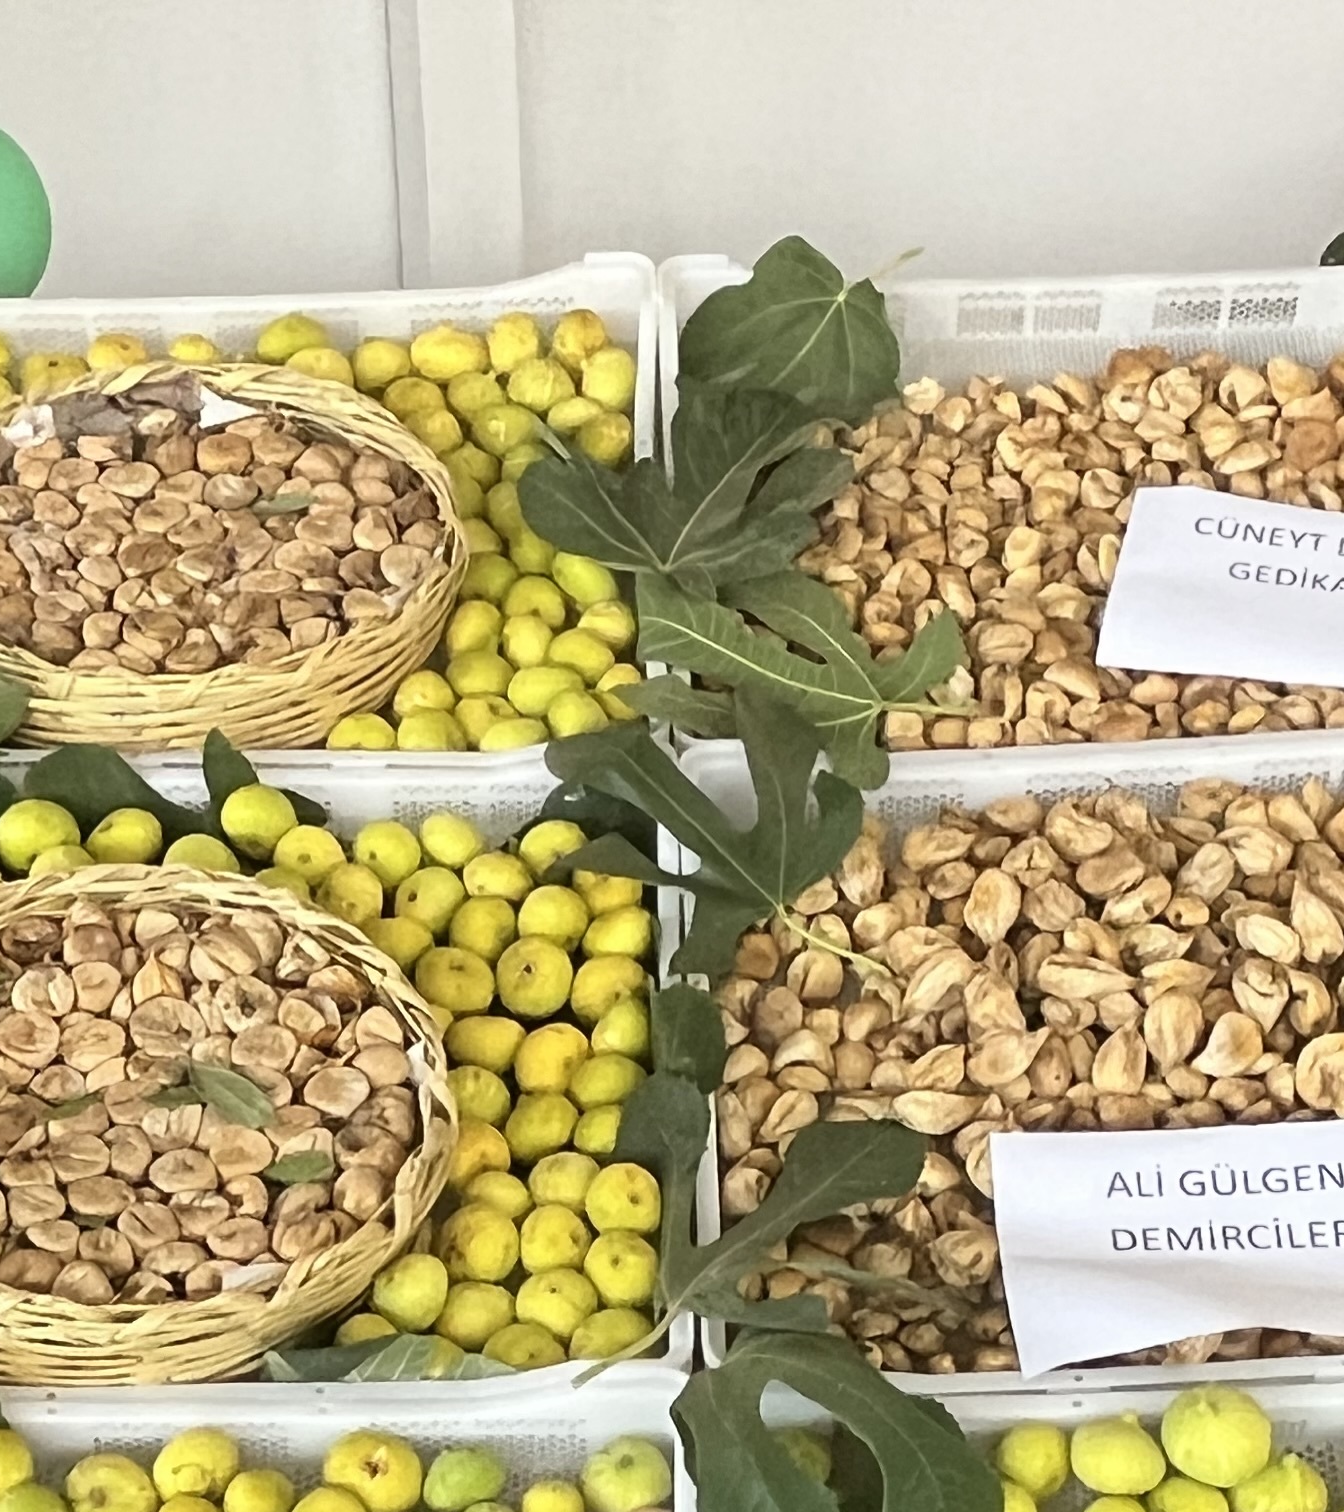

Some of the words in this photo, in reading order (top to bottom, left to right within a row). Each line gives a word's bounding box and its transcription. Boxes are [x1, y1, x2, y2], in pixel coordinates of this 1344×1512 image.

[1194, 515, 1329, 552] CÜNEYT
[1106, 1164, 1164, 1199] ALİ
[1178, 1162, 1344, 1197] GÜLGEN
